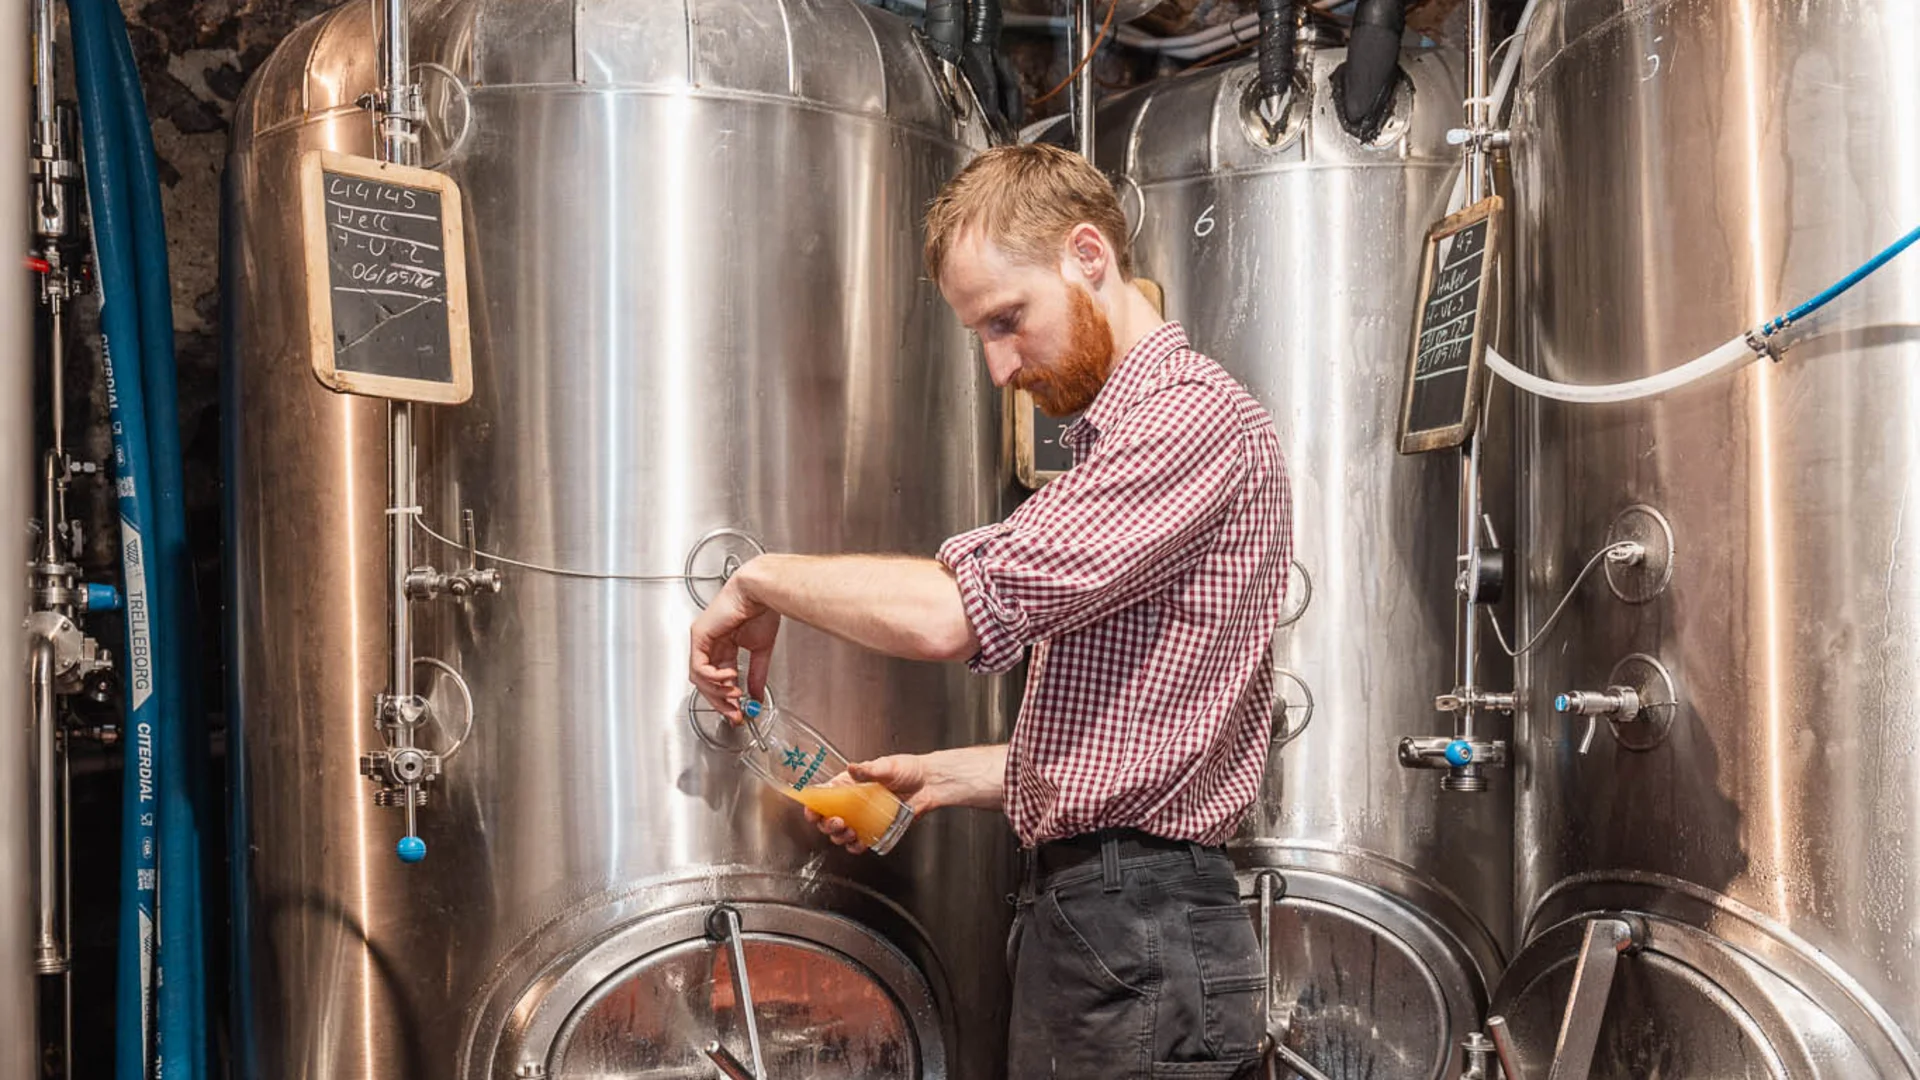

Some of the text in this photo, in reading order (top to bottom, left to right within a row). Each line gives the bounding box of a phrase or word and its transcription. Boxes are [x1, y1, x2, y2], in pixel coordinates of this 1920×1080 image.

[1194, 204, 1215, 237] 6
[129, 591, 149, 691] TRELLEBORG
[137, 722, 153, 803] CITERDIAL
